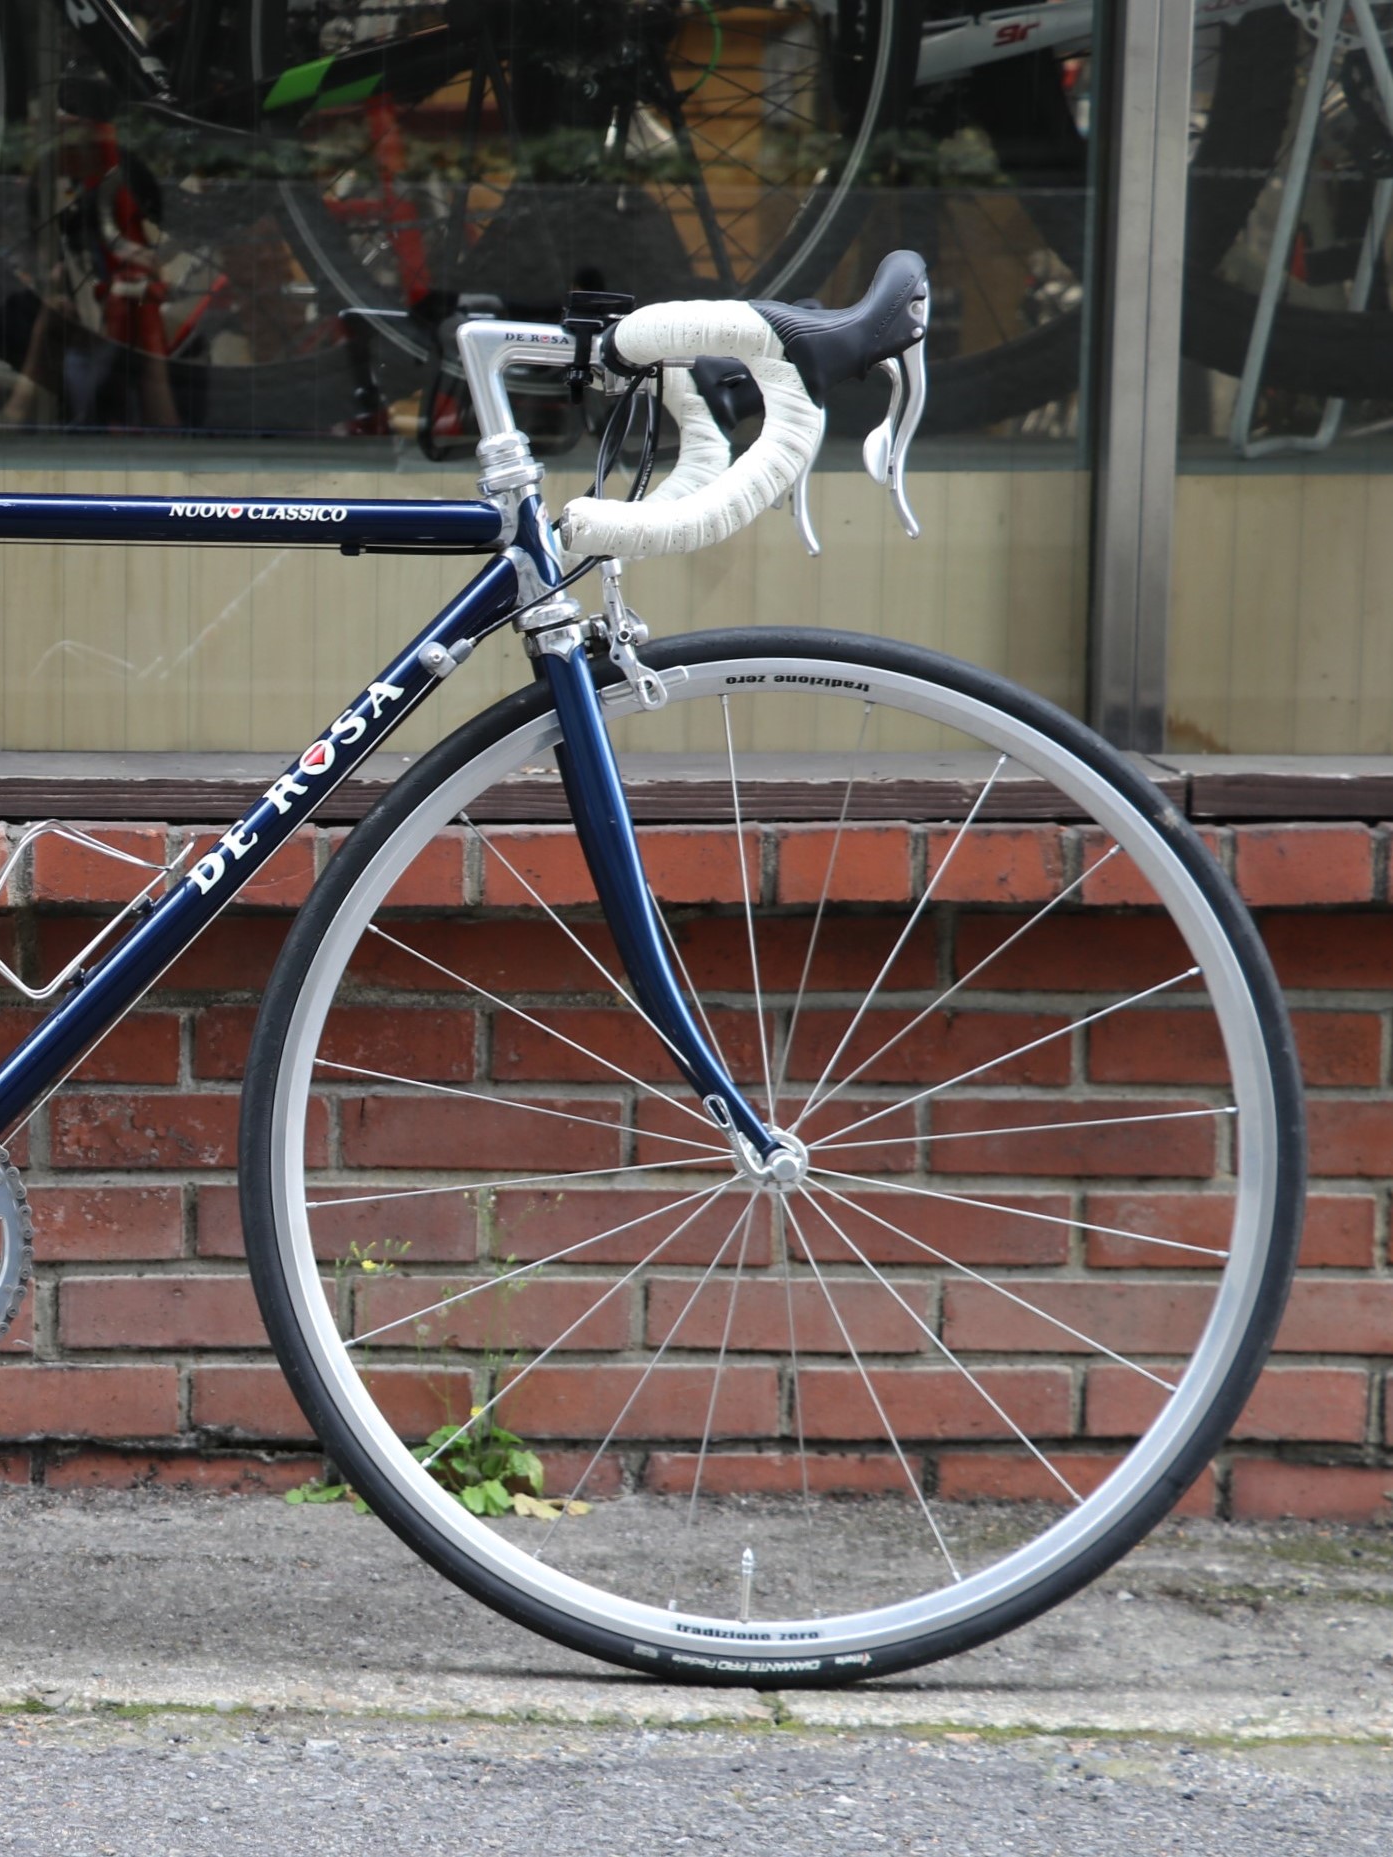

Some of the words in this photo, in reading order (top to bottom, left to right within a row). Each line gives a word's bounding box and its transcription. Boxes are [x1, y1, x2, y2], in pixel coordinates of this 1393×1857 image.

[504, 332, 526, 342] DE
[530, 333, 570, 345] ROSA
[169, 503, 243, 519] NUOVO
[247, 504, 348, 523] CLASSICO
[725, 675, 766, 685] zero
[773, 674, 870, 693] tradizione
[185, 819, 259, 895] DE
[262, 681, 405, 815] ROSA
[675, 1622, 771, 1641] tradizione
[779, 1630, 820, 1641] zero
[717, 1659, 750, 1672] PRO
[749, 1659, 821, 1673] DIAMANTE
